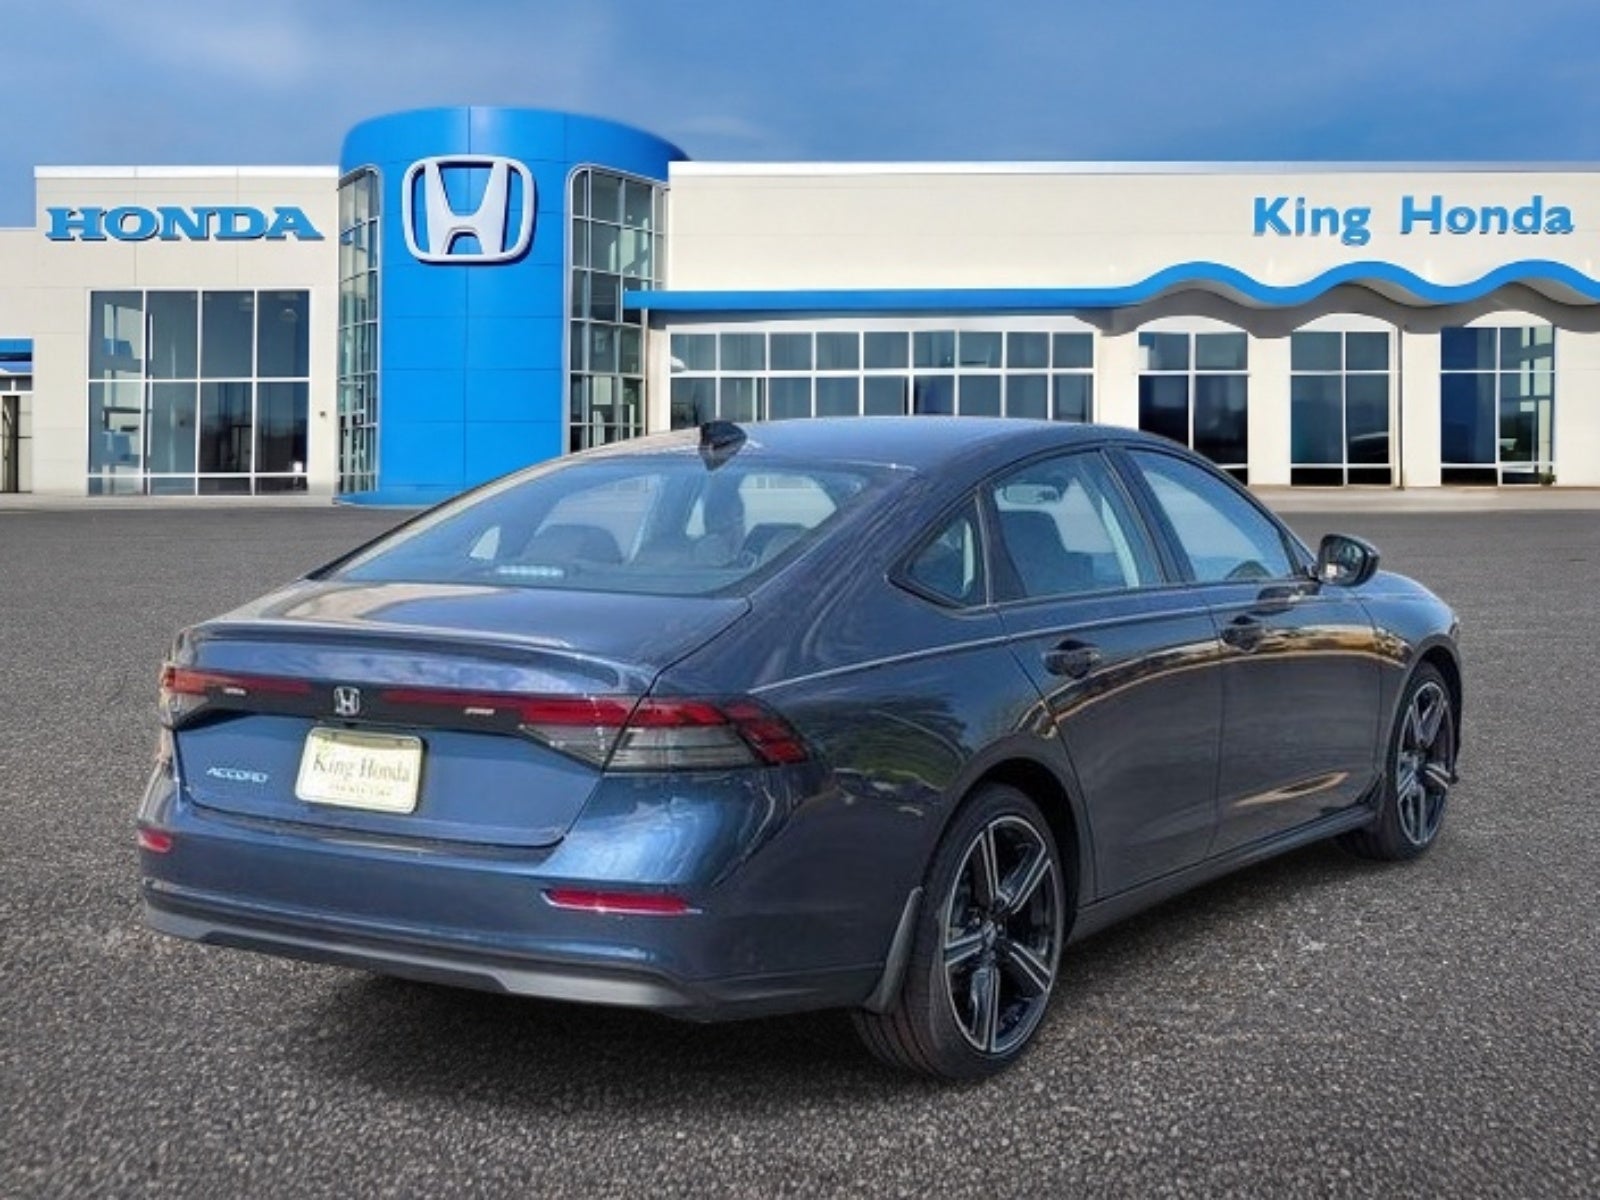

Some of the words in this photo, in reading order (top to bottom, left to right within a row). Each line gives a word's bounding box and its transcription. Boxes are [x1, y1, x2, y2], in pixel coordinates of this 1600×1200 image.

[45, 205, 326, 241] HONDA
[1253, 196, 1372, 246] King
[1399, 194, 1575, 235] Honda
[312, 751, 355, 781] King
[358, 756, 411, 783] Honda
